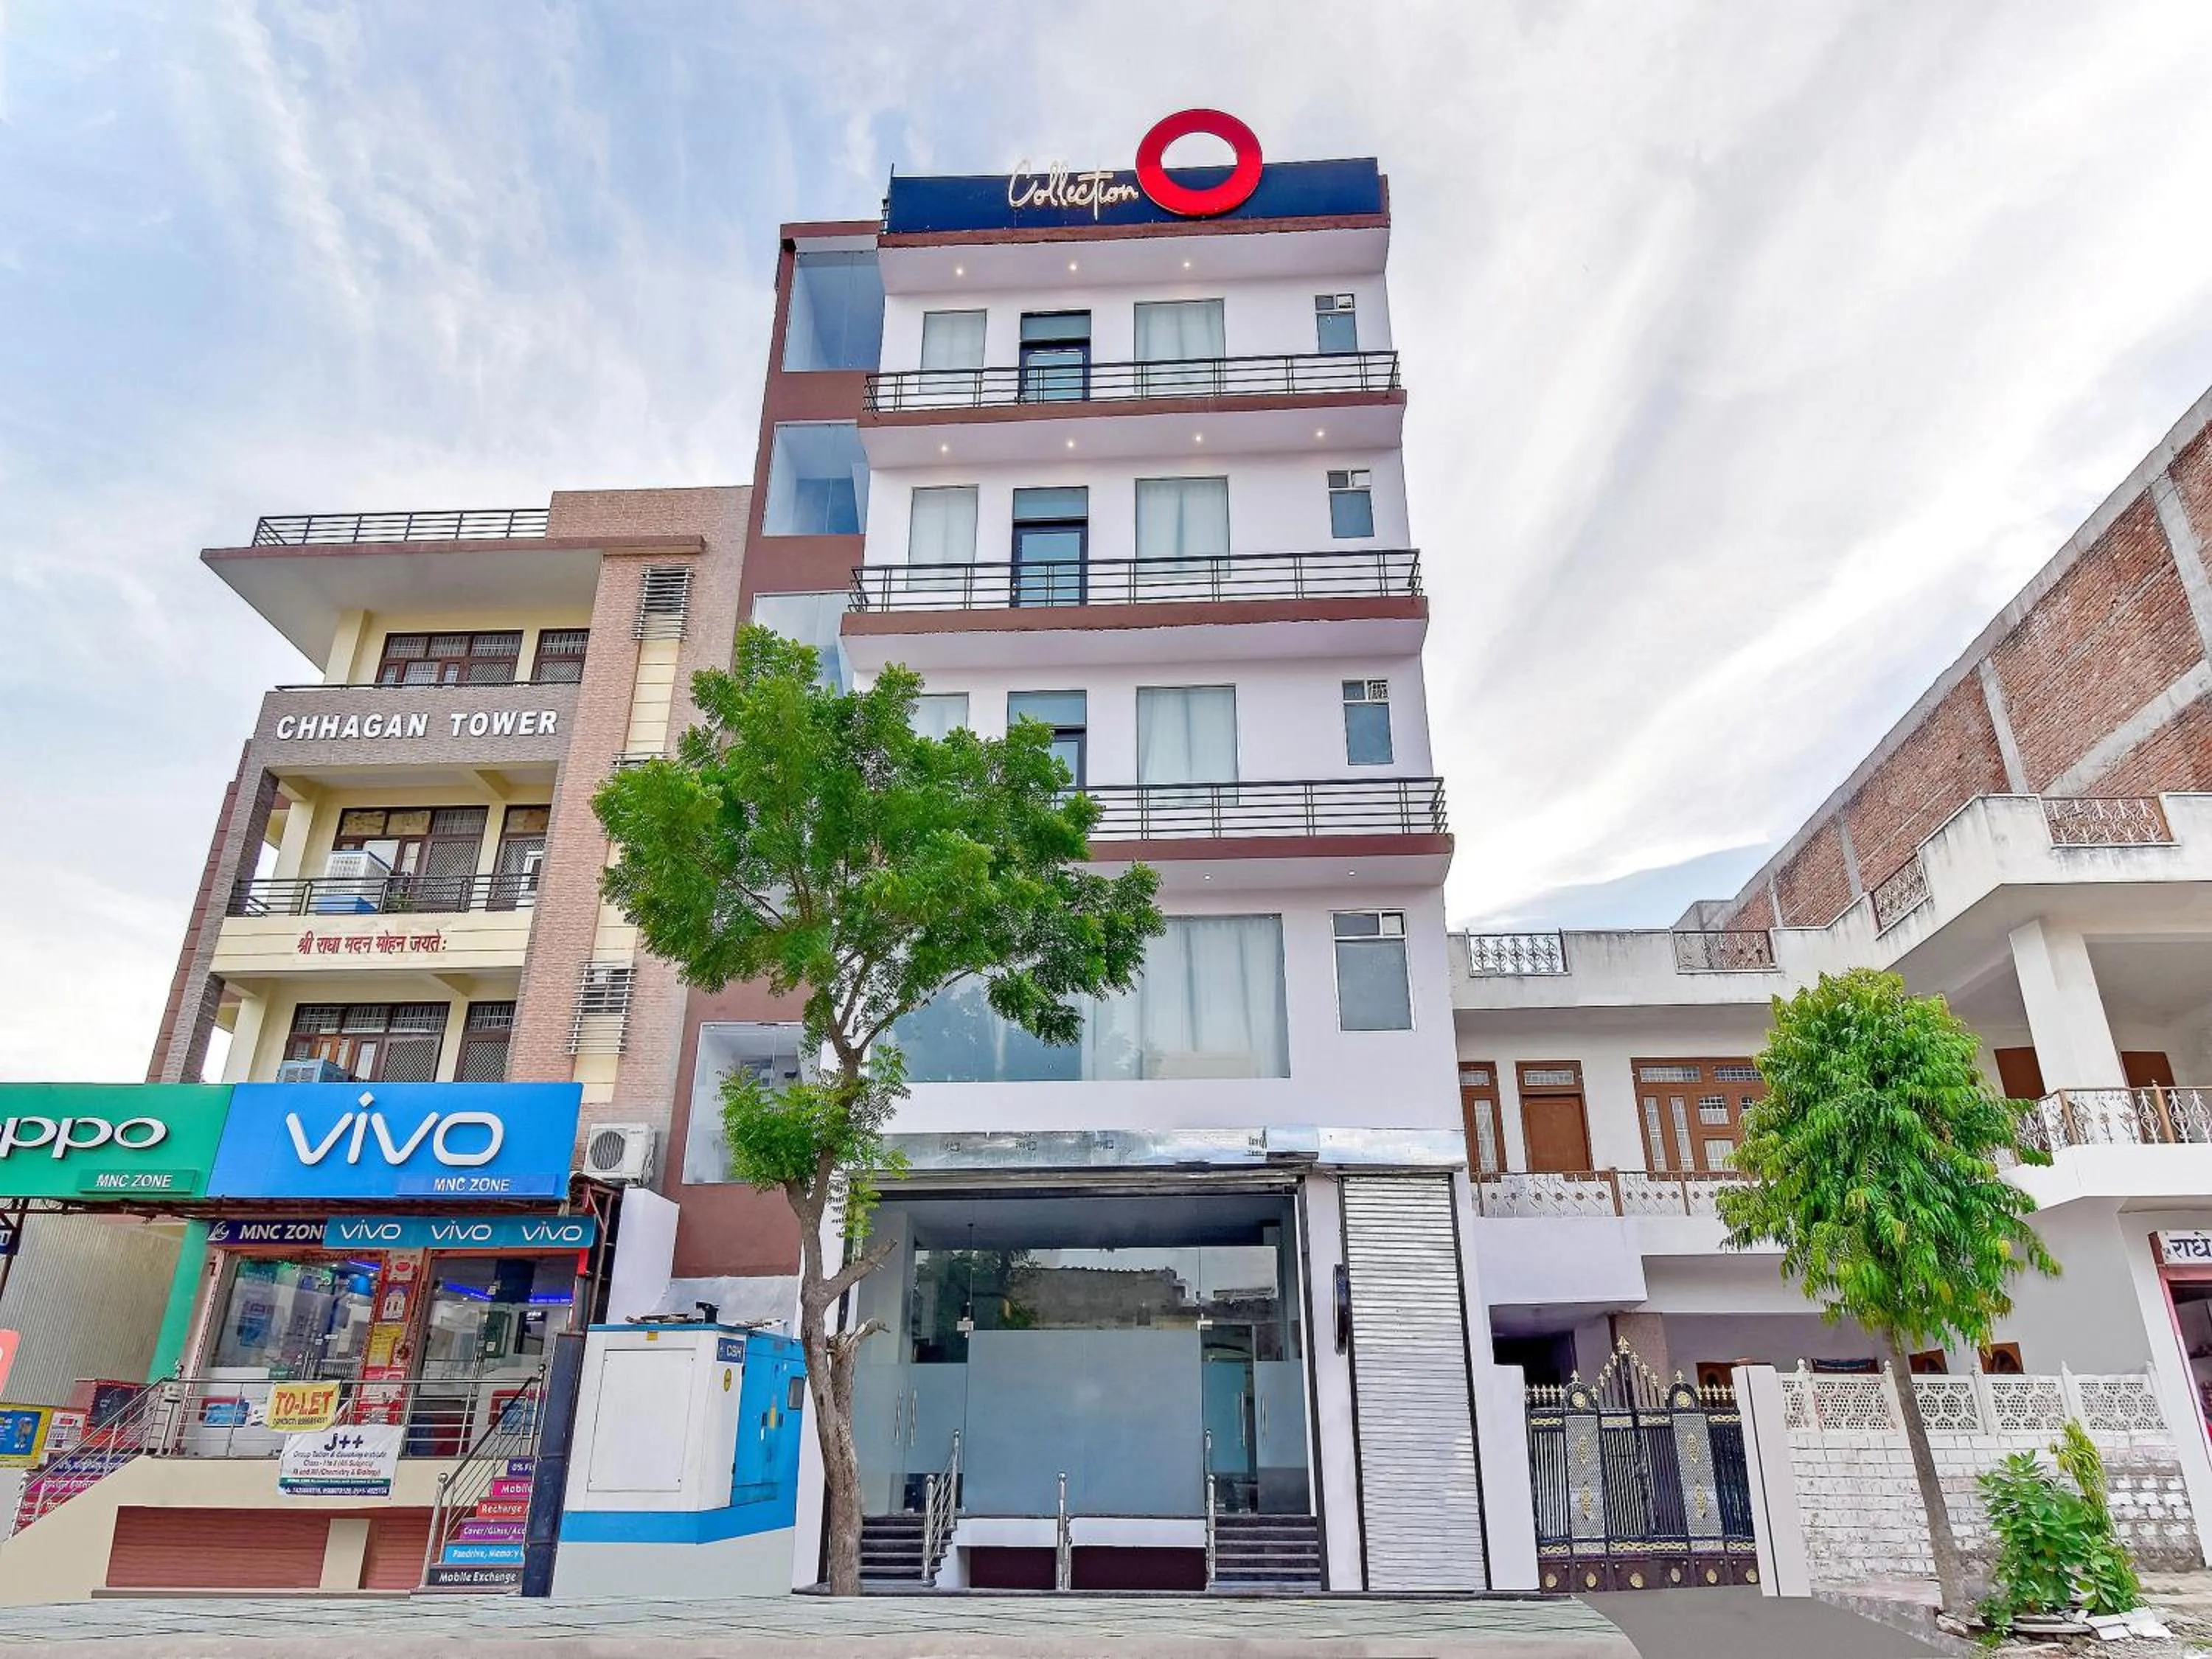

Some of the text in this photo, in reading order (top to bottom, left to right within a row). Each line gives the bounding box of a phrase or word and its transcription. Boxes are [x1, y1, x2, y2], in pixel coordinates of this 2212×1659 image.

[1008, 158, 1139, 221] Collection
[276, 709, 558, 740] CHHAGAN TOWER
[297, 930, 314, 955] श्री
[317, 936, 342, 954] राधा
[344, 936, 373, 954] मदन
[376, 930, 408, 955] मोहन
[0, 1116, 168, 1159] ppo
[286, 1091, 504, 1166] vivo
[96, 1174, 173, 1188] MNC ZONE
[434, 1178, 510, 1192] MNC ZONE
[239, 1224, 280, 1239] MNC
[341, 1219, 402, 1239] vivo
[431, 1220, 492, 1241] vivo
[522, 1221, 582, 1241] vivo
[481, 1504, 522, 1514] Recharge
[439, 1571, 516, 1583] Mobile Exchange
